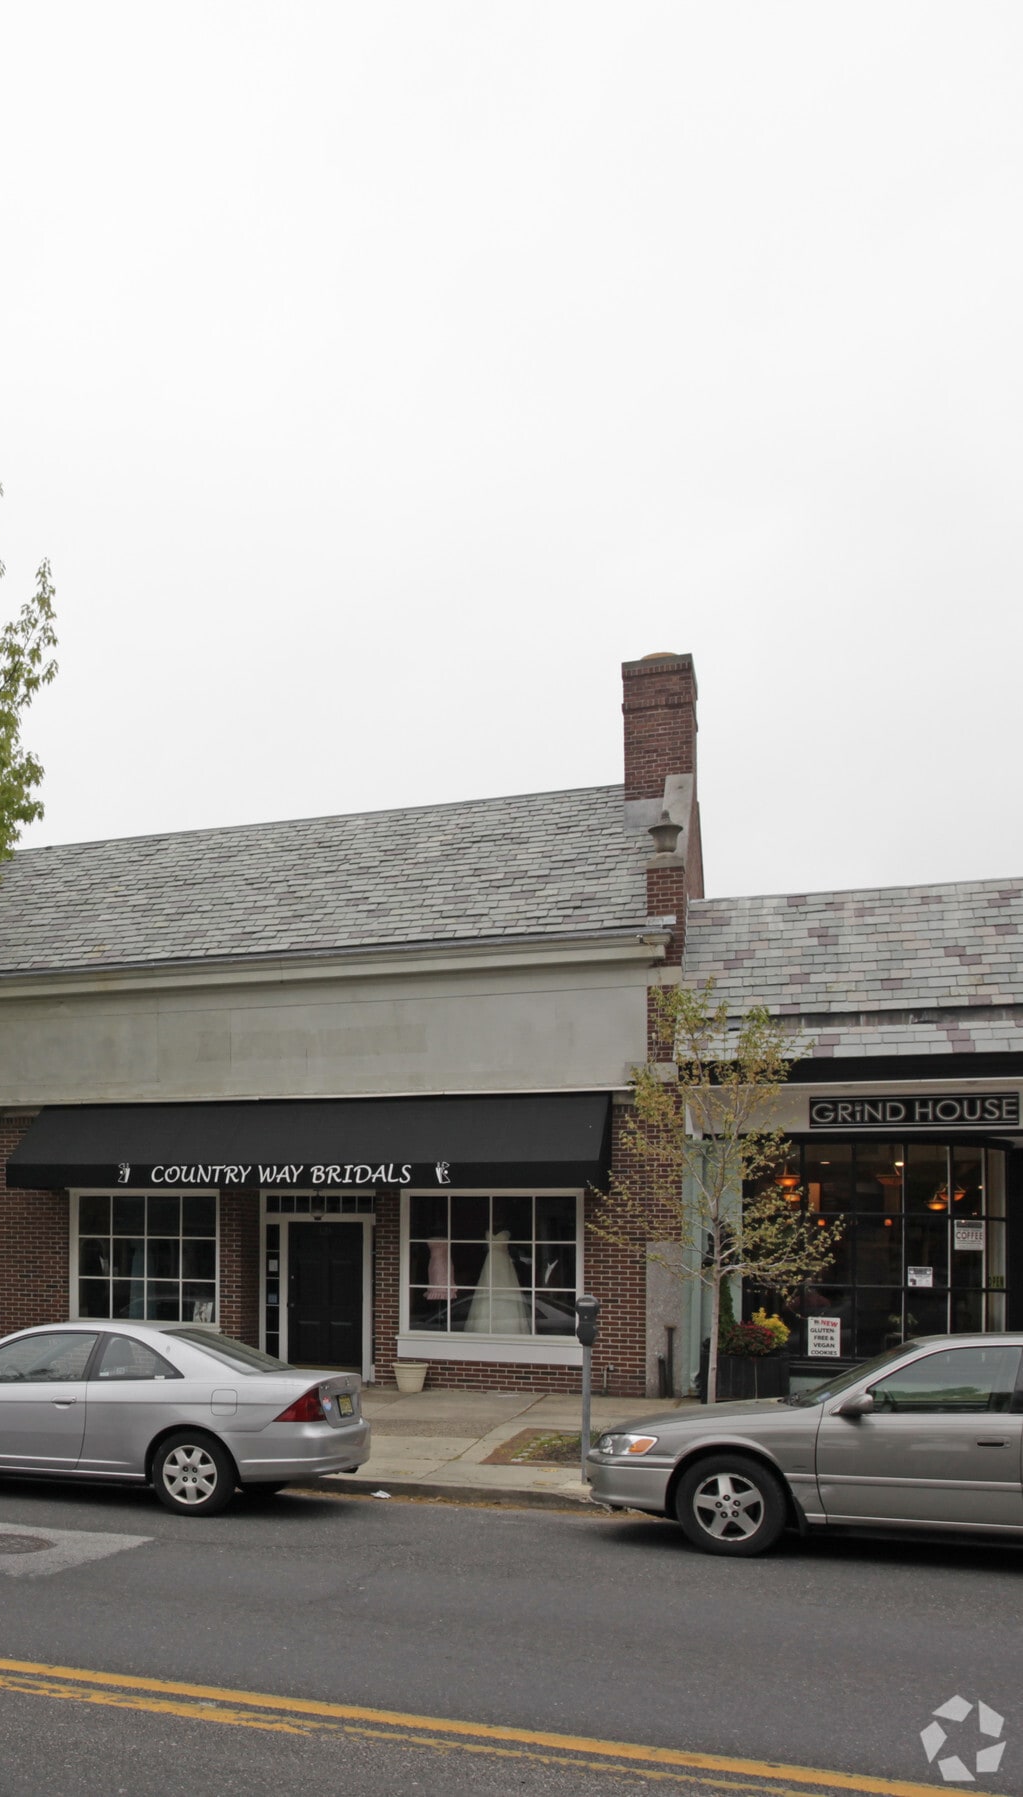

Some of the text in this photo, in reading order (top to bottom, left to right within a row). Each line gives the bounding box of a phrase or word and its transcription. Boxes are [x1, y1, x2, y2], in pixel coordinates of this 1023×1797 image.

[914, 1098, 1017, 1122] HOUSE
[151, 1163, 412, 1184] COUNTRY WAY BRIDALS
[956, 1231, 983, 1240] COFFEE
[821, 1319, 839, 1328] NEW
